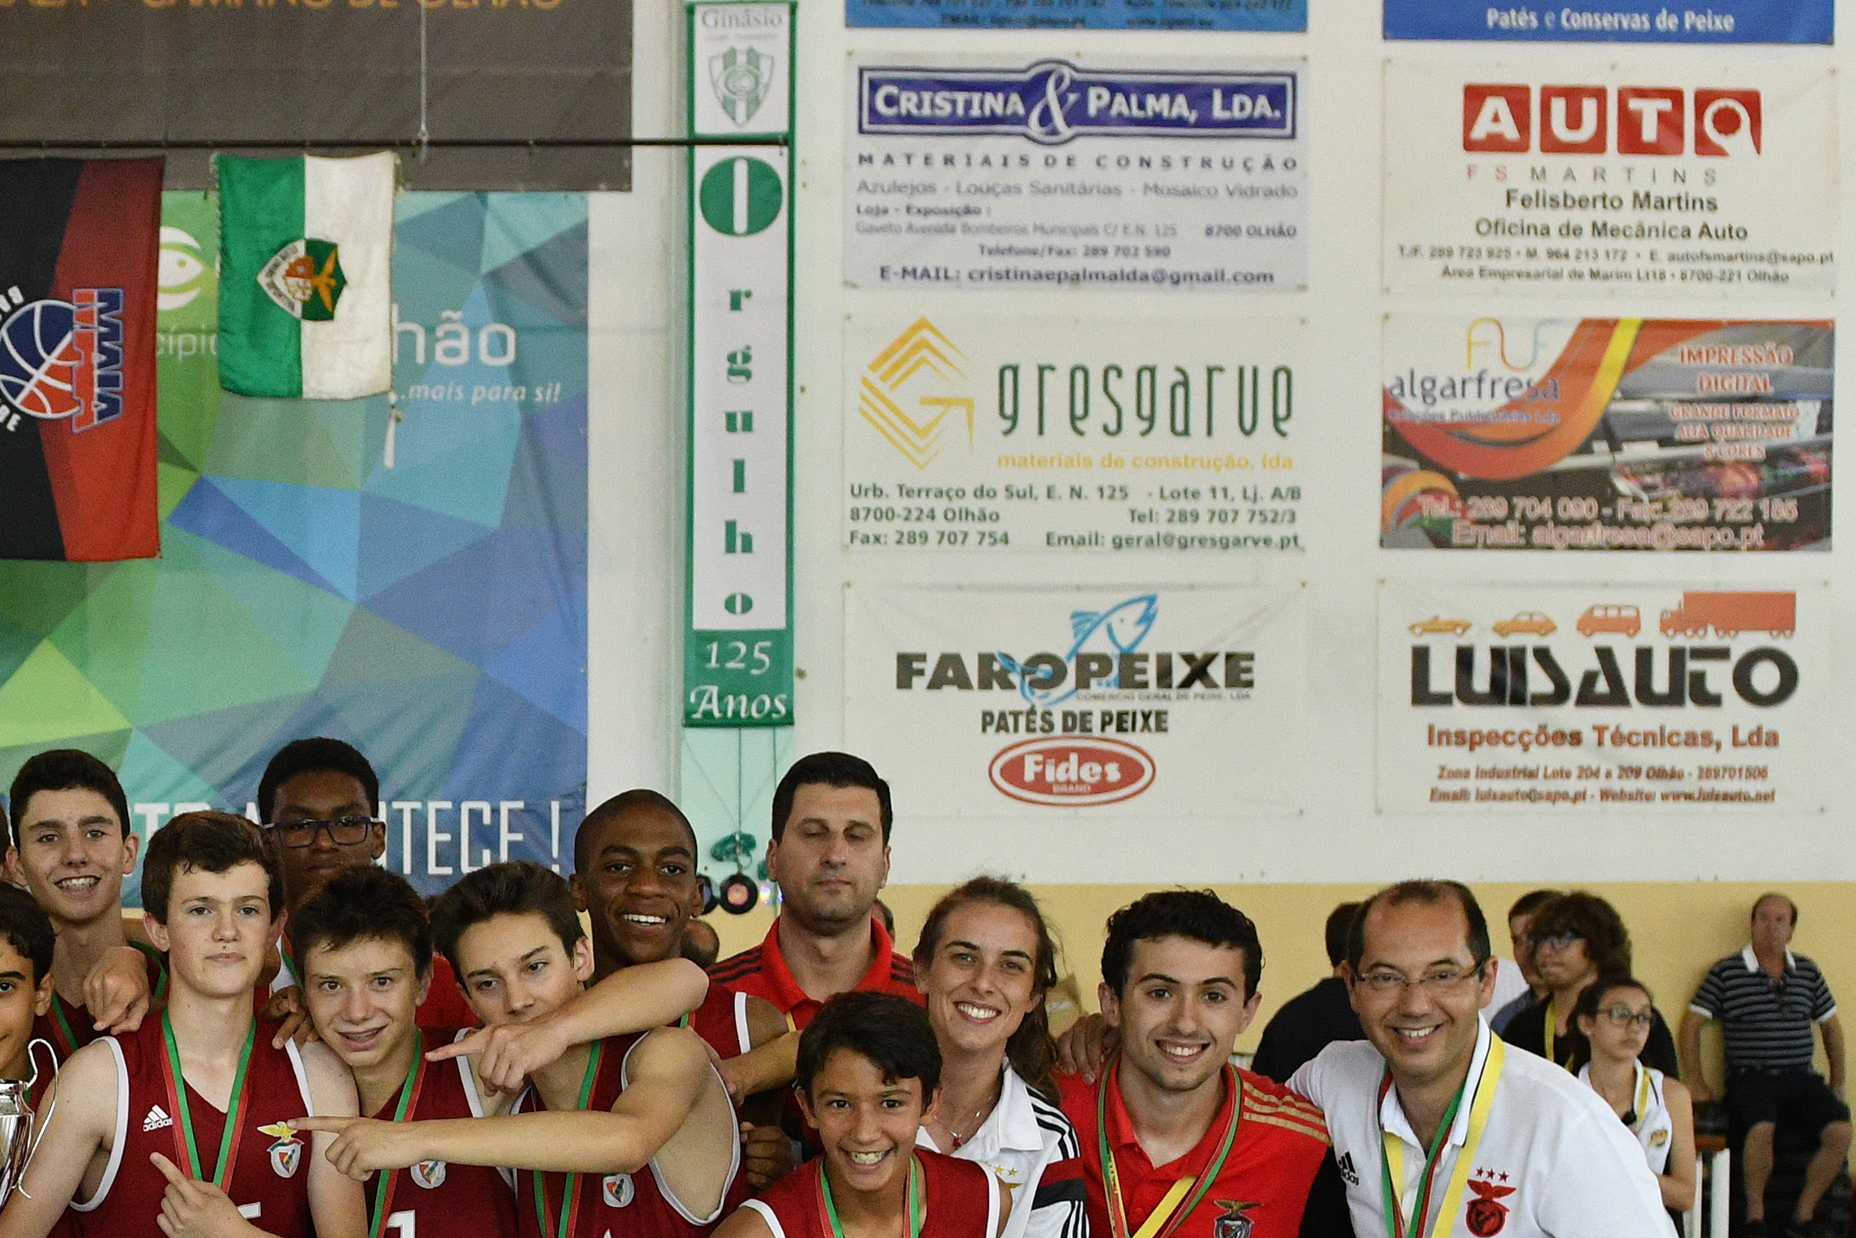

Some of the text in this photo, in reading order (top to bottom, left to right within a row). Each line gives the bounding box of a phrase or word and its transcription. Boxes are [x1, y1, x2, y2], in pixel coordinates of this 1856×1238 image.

[1486, 8, 1735, 32] Patés e Conservas de Peixe
[874, 66, 1281, 137] CRISTINA & PALMA, LDA.
[1466, 90, 1761, 157] AUTO
[858, 150, 1297, 172] MATERIAIS DE CONSTRUÇÃO
[1531, 165, 1717, 185] MARTINS
[856, 179, 1298, 198] Azulejos Louças Sanitárias Mosaico Vidrado
[1506, 189, 1718, 212] Felisberto Martins
[1475, 218, 1748, 240] Oficina de Mecânica Auto
[879, 264, 961, 281] E-MAIL:
[1679, 342, 1794, 366] IMPRESSÃO
[472, 382, 562, 404] para si!
[698, 156, 783, 615] Orgulho
[1388, 368, 1561, 404] algarfresa
[1698, 374, 1774, 393] DIGITAL
[998, 363, 1294, 438] gresgarve
[997, 452, 1094, 469] materiais
[1100, 453, 1126, 469] de
[1261, 453, 1293, 470] lda
[850, 484, 889, 499] Urb.
[896, 484, 967, 503] Terraço
[973, 484, 998, 500] do
[1004, 484, 1040, 503] Sul,
[1097, 484, 1129, 500] 125
[1159, 485, 1201, 501] Lote
[1270, 485, 1302, 501] A/B
[850, 506, 1297, 525] 8700-224 Olhão Tel: 289 707 752/3
[850, 530, 888, 546] Fax:
[894, 530, 929, 546] 289
[935, 530, 969, 546] 707
[975, 530, 1010, 546] 754
[1045, 531, 1105, 548] Email:
[705, 640, 773, 676] 125
[896, 652, 1255, 690] FAROPEIXE
[1411, 645, 1799, 707] LUISAUTO
[689, 684, 788, 720] Anos
[981, 705, 1169, 733] PATÉS DE PEIXE
[1427, 724, 1779, 752] Inspecções Técnicas, Lda
[1024, 754, 1122, 784] Fides
